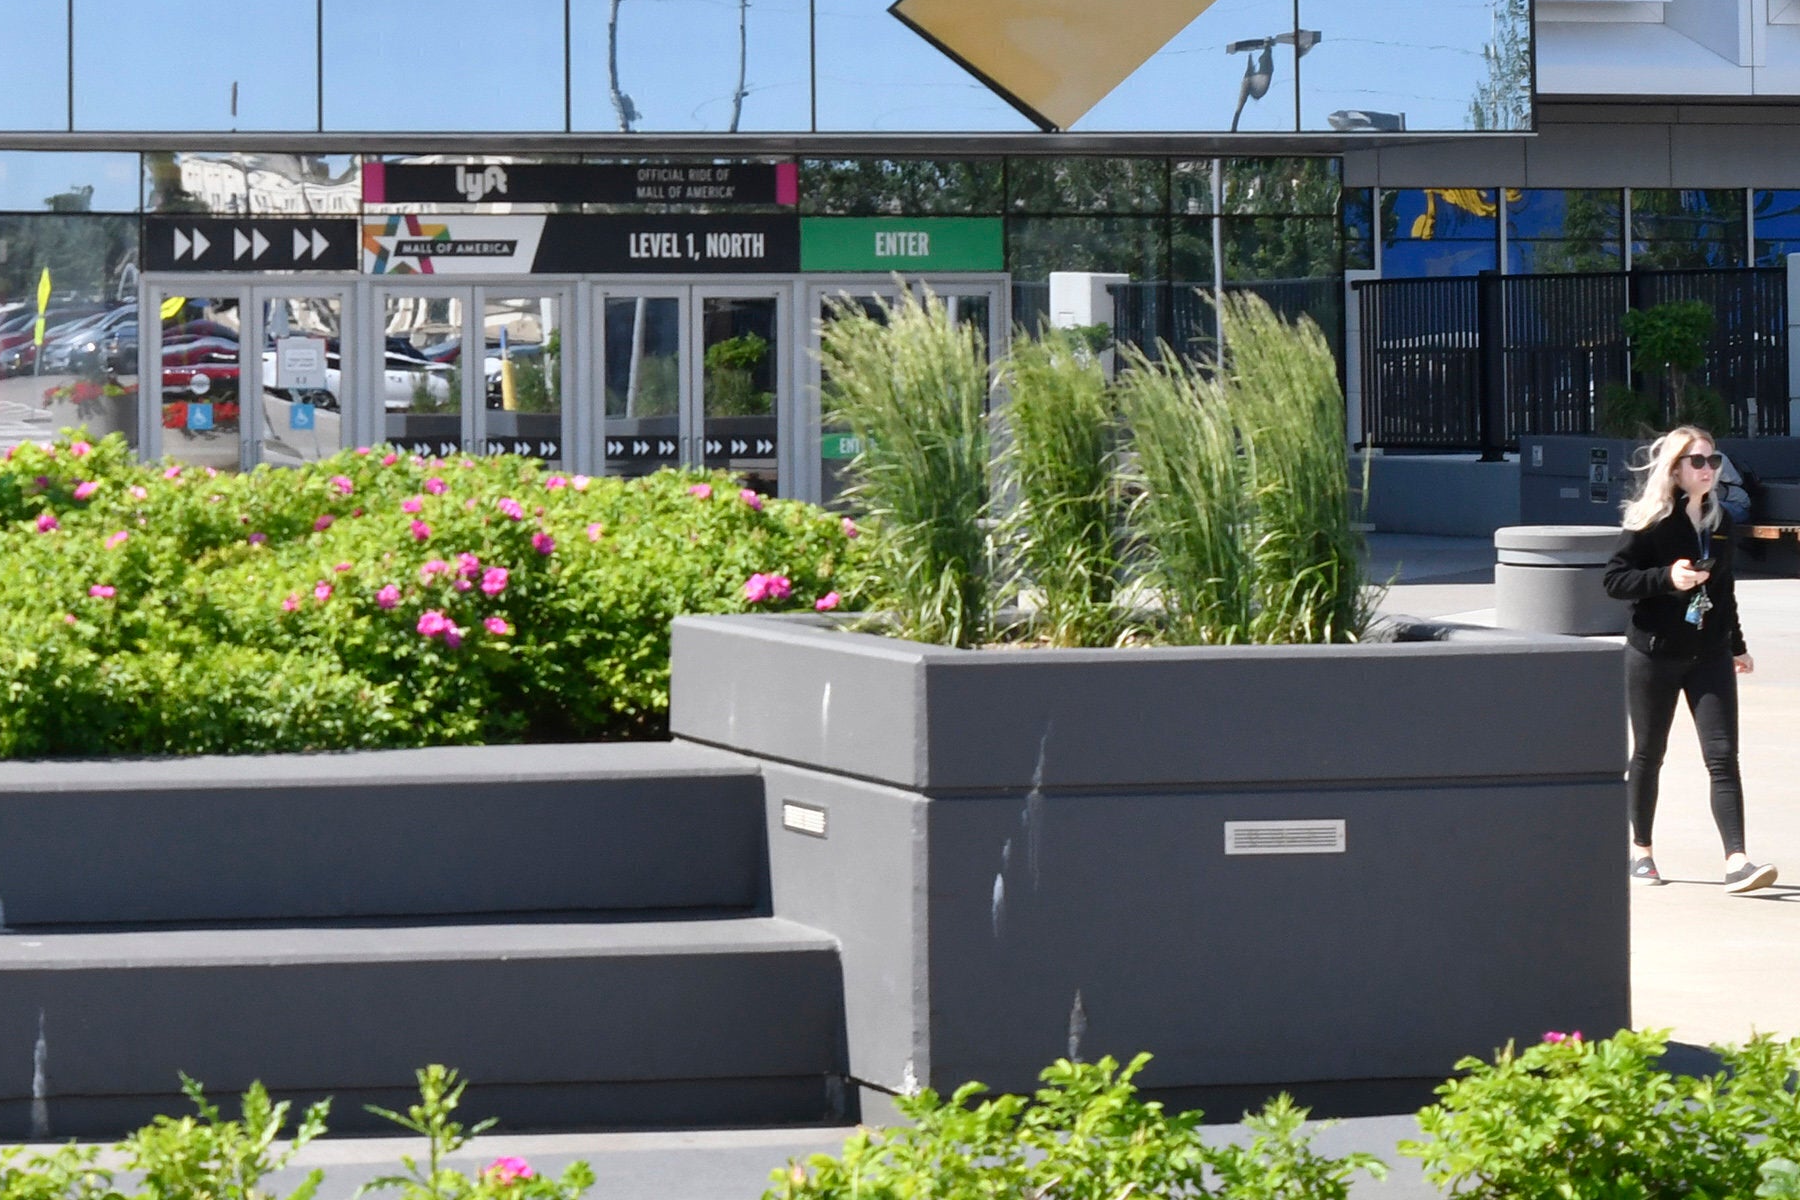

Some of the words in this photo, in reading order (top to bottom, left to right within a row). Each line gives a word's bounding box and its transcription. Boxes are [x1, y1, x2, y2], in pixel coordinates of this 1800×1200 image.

[636, 168, 685, 182] OFFICIAL
[688, 168, 713, 182] RIDE
[715, 168, 731, 182] OF
[636, 186, 665, 199] MALL
[668, 186, 682, 199] OF
[401, 243, 432, 254] MALL
[435, 243, 452, 254] OF
[455, 243, 510, 254] AMERICA
[629, 232, 682, 259] LEVEL
[685, 233, 701, 261] 1,
[705, 232, 766, 259] NORTH
[874, 231, 930, 257] ENTER
